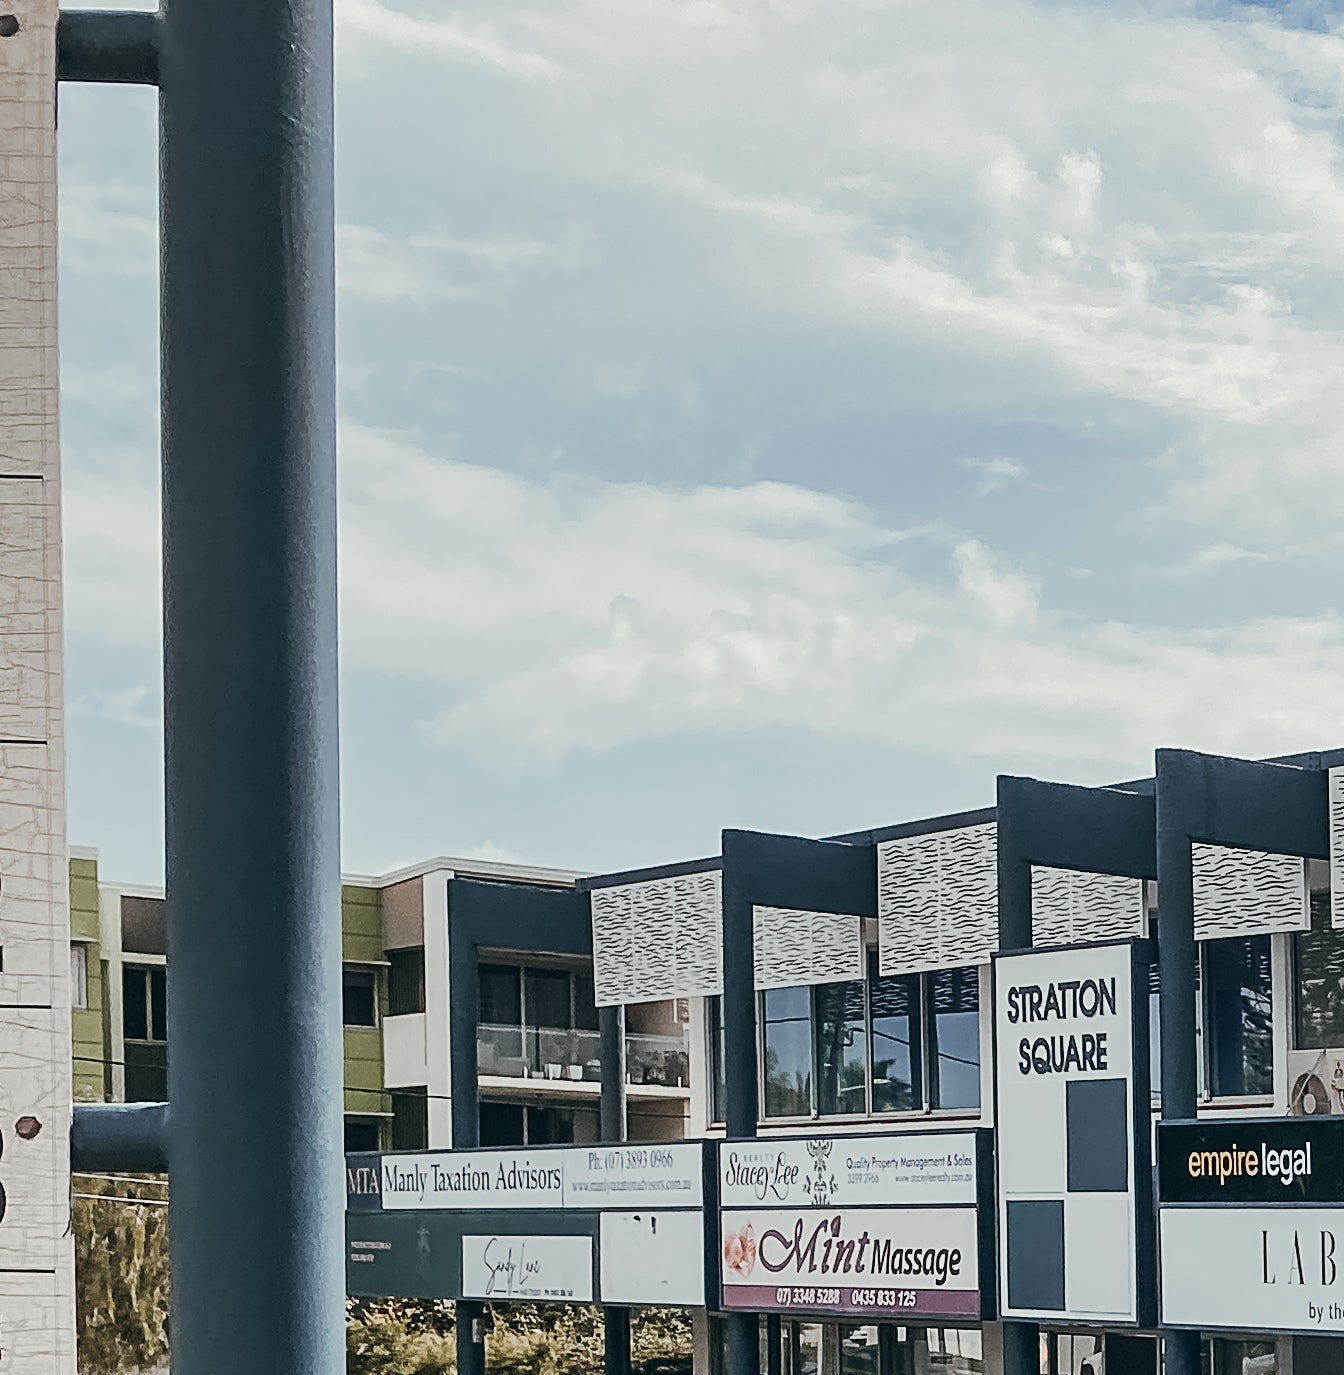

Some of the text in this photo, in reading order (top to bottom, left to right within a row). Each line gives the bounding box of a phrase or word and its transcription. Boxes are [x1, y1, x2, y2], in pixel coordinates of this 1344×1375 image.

[1007, 976, 1117, 1024] STRATTON
[1018, 1032, 1108, 1075] SQUARE
[346, 1168, 380, 1194] MTA
[385, 1161, 561, 1202] Manly Taxation Advisors
[605, 1151, 624, 1171] (07)
[726, 1151, 799, 1200] Stacey Lee
[846, 1156, 870, 1171] Quality
[872, 1156, 899, 1171] Property
[900, 1156, 946, 1170] Management
[954, 1154, 972, 1167] Sales
[1188, 1143, 1259, 1186] empire
[1261, 1141, 1312, 1186] legal
[758, 1215, 962, 1285] Mint Massage
[793, 1288, 815, 1304] 3348
[816, 1288, 840, 1304] 5288
[851, 1290, 875, 1305] 0435
[877, 1290, 896, 1306] 833
[898, 1290, 917, 1307] 125
[1308, 1302, 1324, 1321] by
